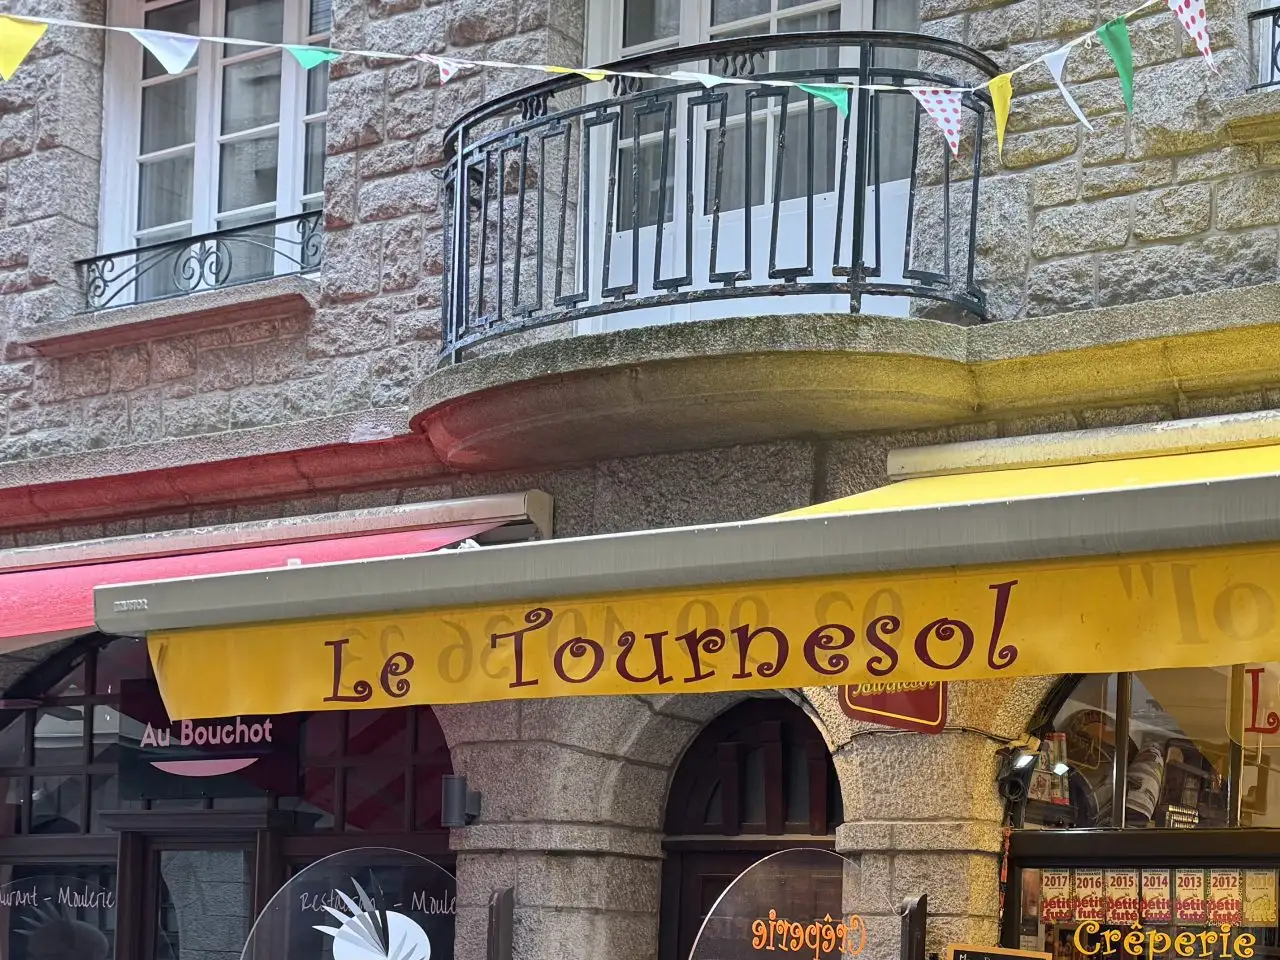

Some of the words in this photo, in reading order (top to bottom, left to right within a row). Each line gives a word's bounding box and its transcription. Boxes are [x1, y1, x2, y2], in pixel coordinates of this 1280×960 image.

[322, 637, 415, 703] Le
[490, 579, 1020, 689] Tournesol
[139, 721, 171, 747] Au
[179, 715, 273, 747] Bouchot
[1044, 875, 1068, 887] 2017
[1076, 877, 1101, 889] 2016
[1110, 875, 1134, 887] 2015
[1143, 875, 1168, 887] 2014
[1177, 876, 1202, 888] 2013
[1212, 876, 1238, 888] 2012
[0, 886, 38, 907] urant
[58, 885, 115, 908] Moulerie
